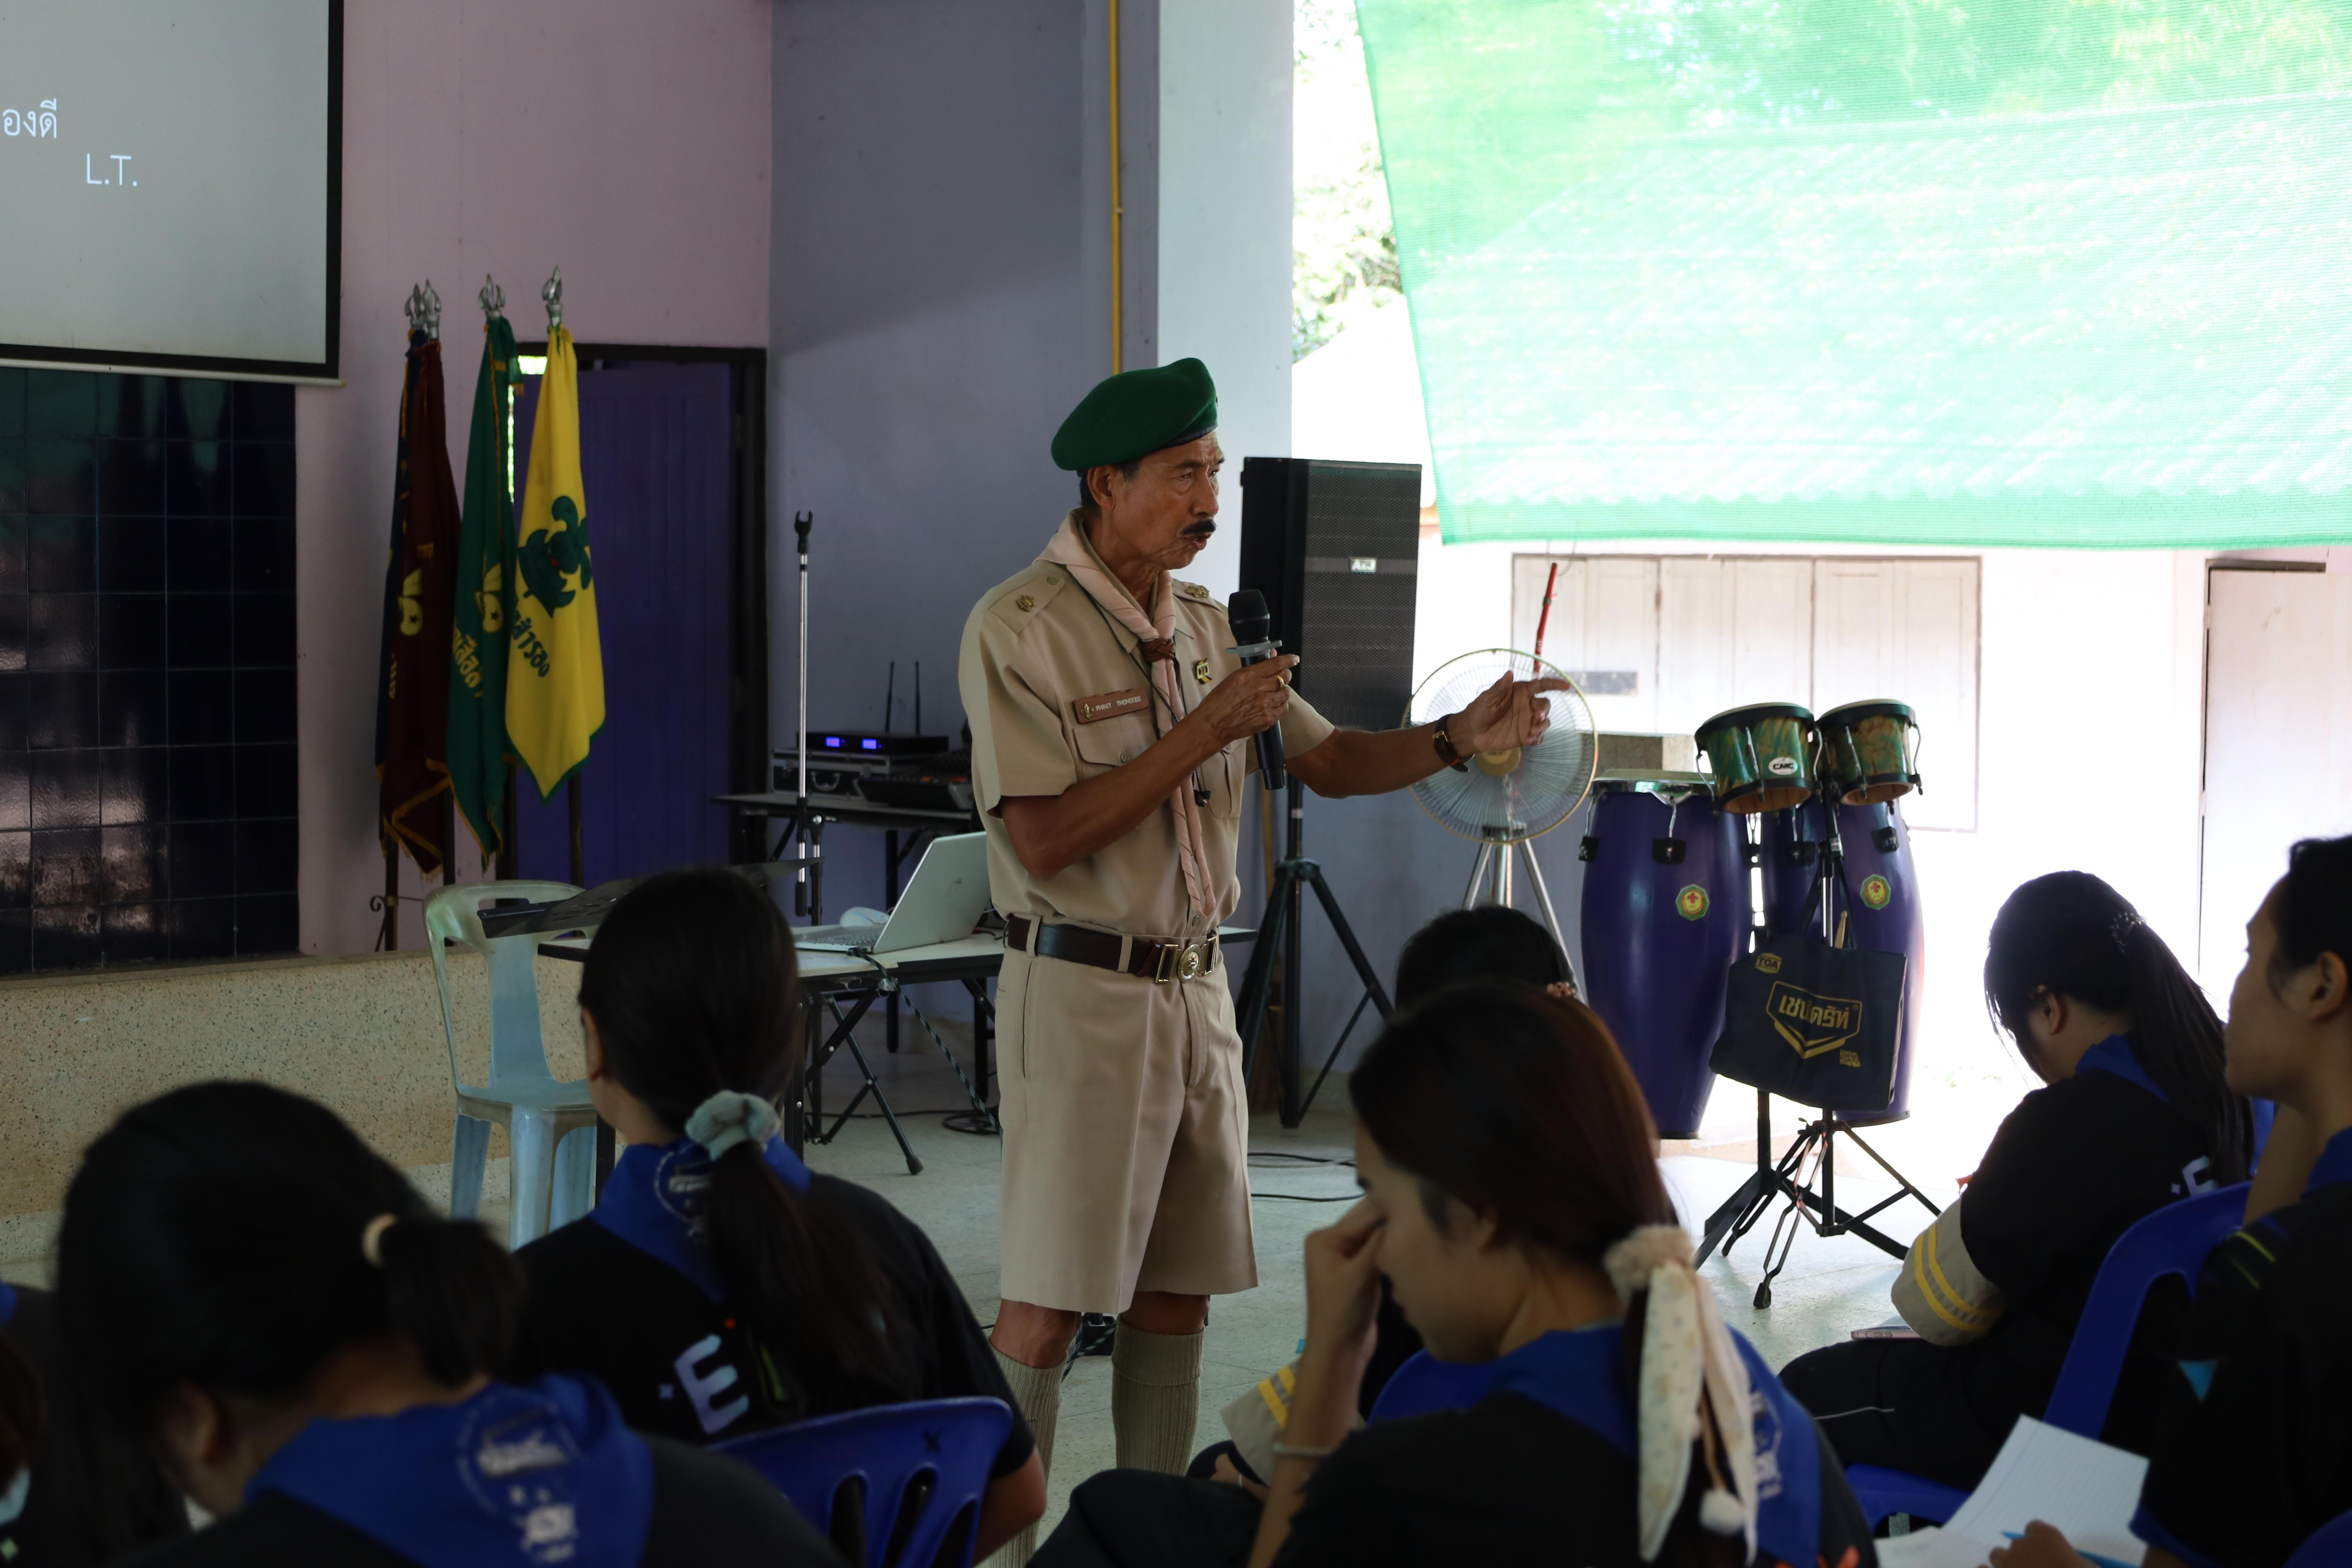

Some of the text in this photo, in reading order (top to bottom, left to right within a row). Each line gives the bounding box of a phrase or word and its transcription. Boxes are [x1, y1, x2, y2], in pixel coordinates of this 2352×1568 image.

[3, 97, 57, 139] องดี
[86, 153, 138, 187] L.T.
[1759, 957, 1778, 970] TOA
